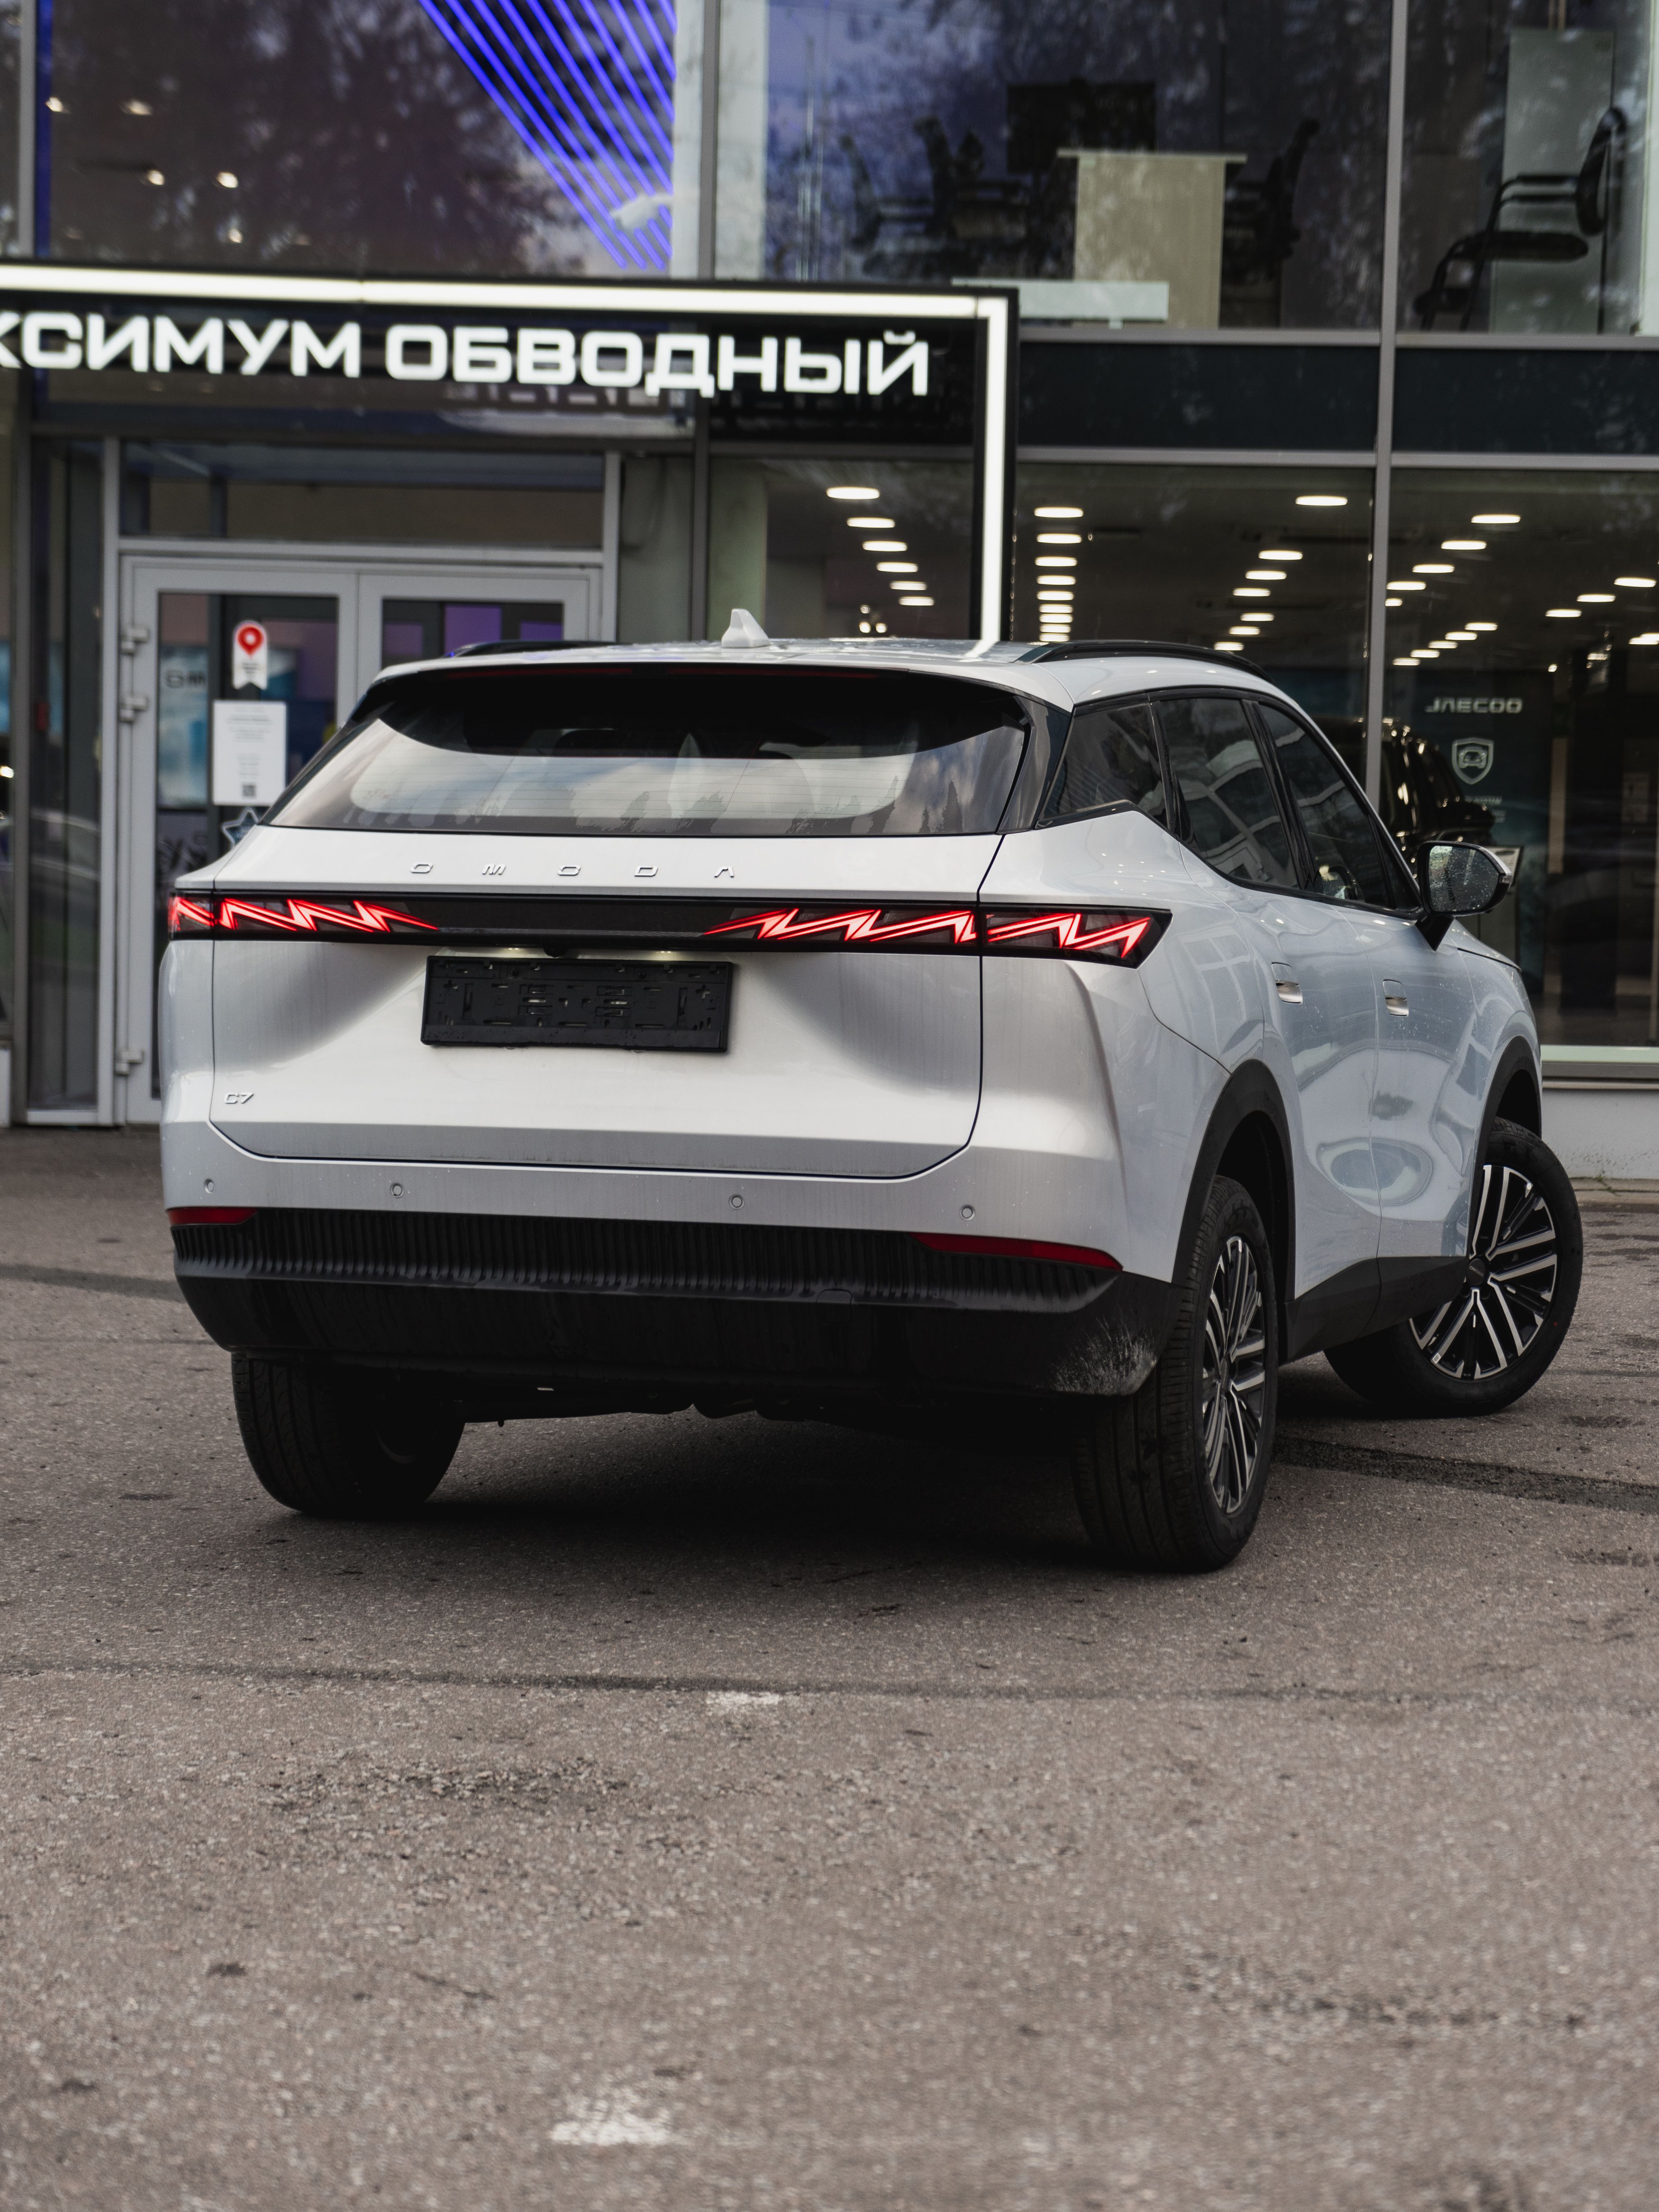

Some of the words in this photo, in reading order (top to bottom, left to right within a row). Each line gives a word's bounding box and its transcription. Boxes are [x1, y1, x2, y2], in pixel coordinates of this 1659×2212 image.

[386, 324, 929, 397] ОБВОДНЫЙ
[1425, 697, 1523, 713] JAECOO
[410, 862, 735, 878] OMODA
[224, 1092, 254, 1104] C7
